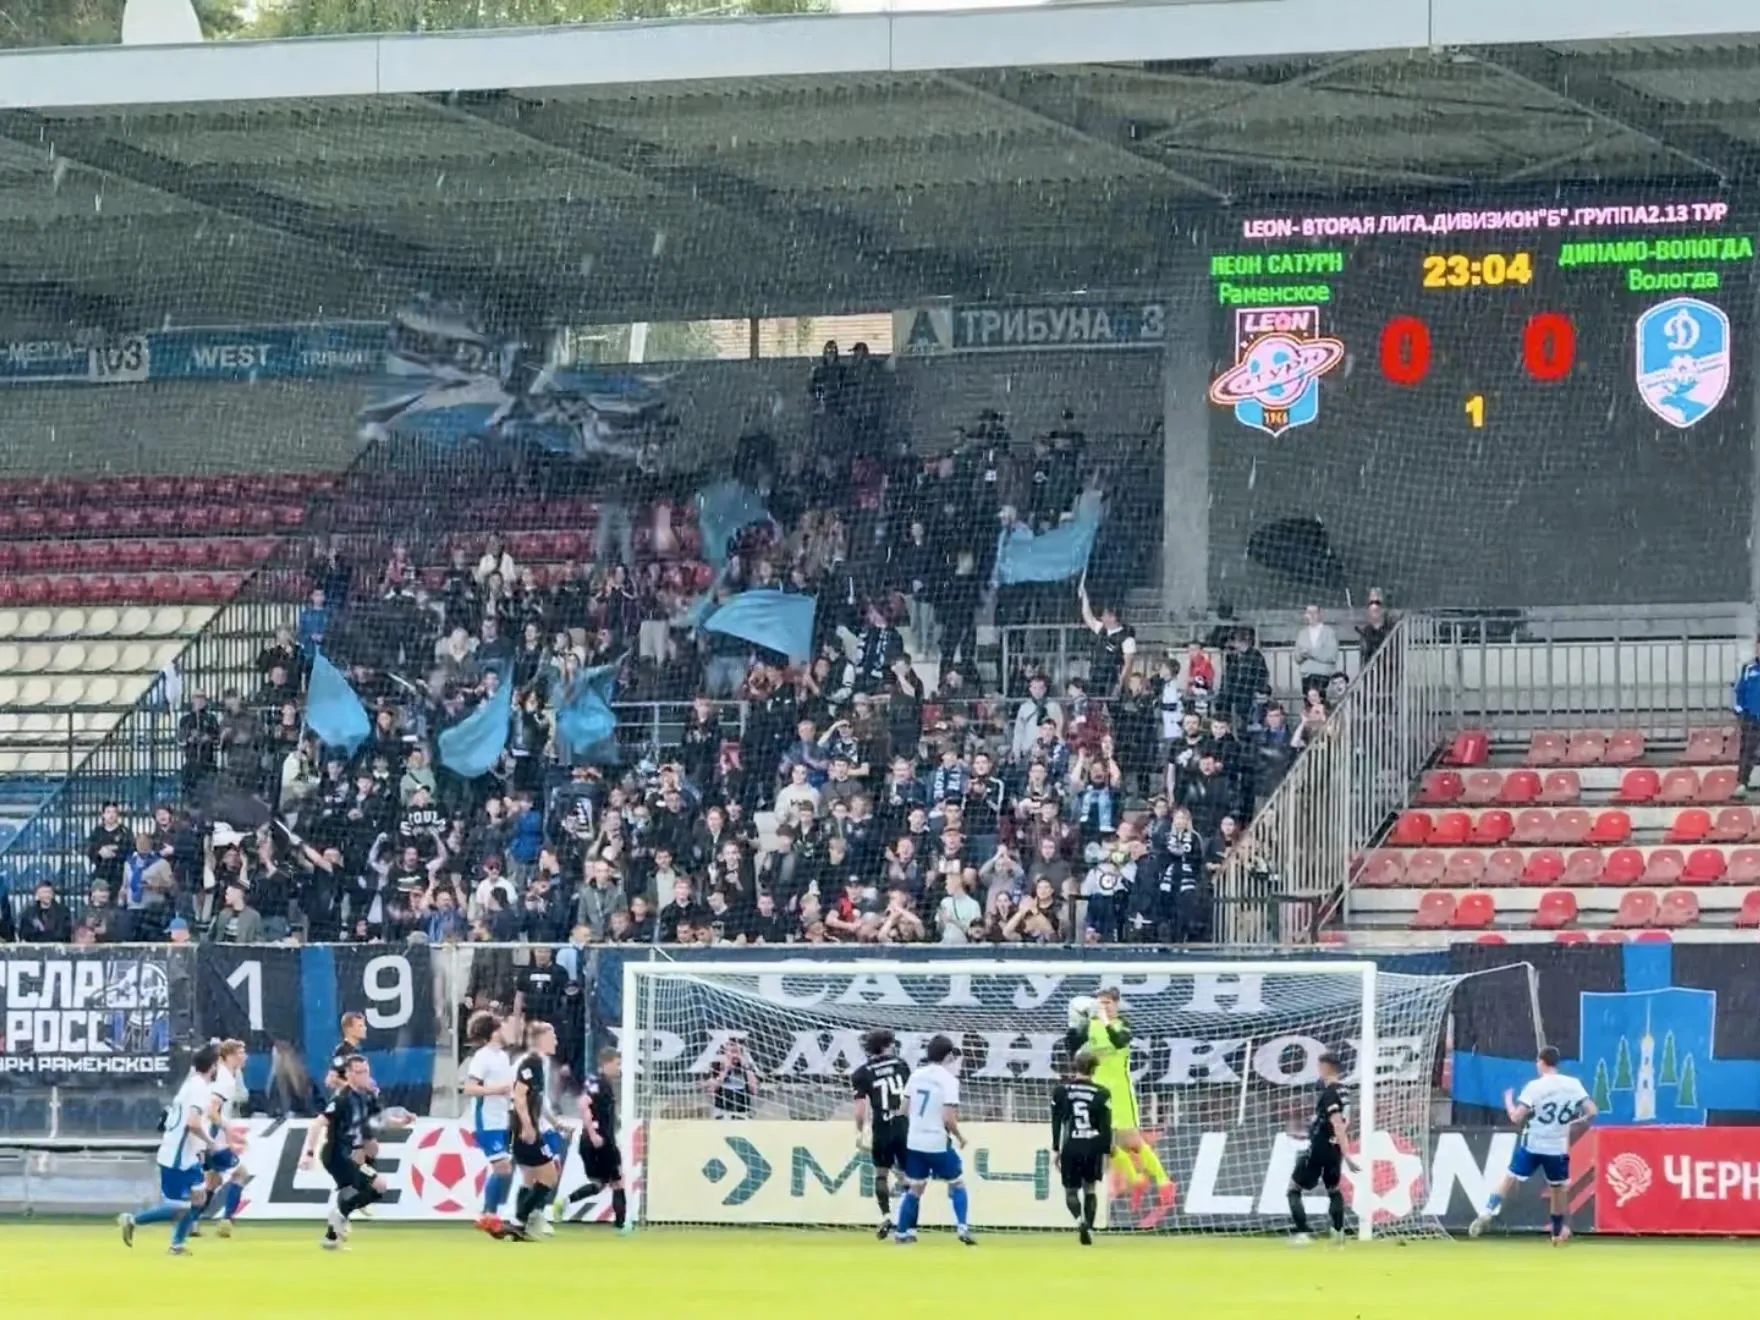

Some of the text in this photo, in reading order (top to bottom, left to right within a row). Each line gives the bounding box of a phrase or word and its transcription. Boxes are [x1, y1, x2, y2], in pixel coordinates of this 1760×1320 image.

[1243, 219, 1299, 238] LEON-
[1302, 216, 1375, 236] ВТОРАЯ
[1691, 202, 1728, 221] ТУР
[1267, 252, 1343, 274] САТУРН
[1558, 237, 1753, 267] ДИНАМО-ВОЛОГДА
[1422, 253, 1533, 288] 23:04
[1628, 268, 1719, 291] Вологда
[1219, 282, 1330, 304] Раменское
[961, 306, 1113, 344] ТРИБУНА
[1245, 312, 1310, 332] LEON
[190, 342, 270, 369] WEST
[1379, 314, 1432, 386] 0
[1522, 311, 1576, 382] 0
[1465, 395, 1484, 428] 1
[38, 1056, 170, 1073] РАМЕНСКОЕ
[873, 1073, 905, 1110] 74
[916, 1088, 931, 1119] 7
[1073, 1100, 1092, 1129] 5
[1538, 1100, 1573, 1125] 36
